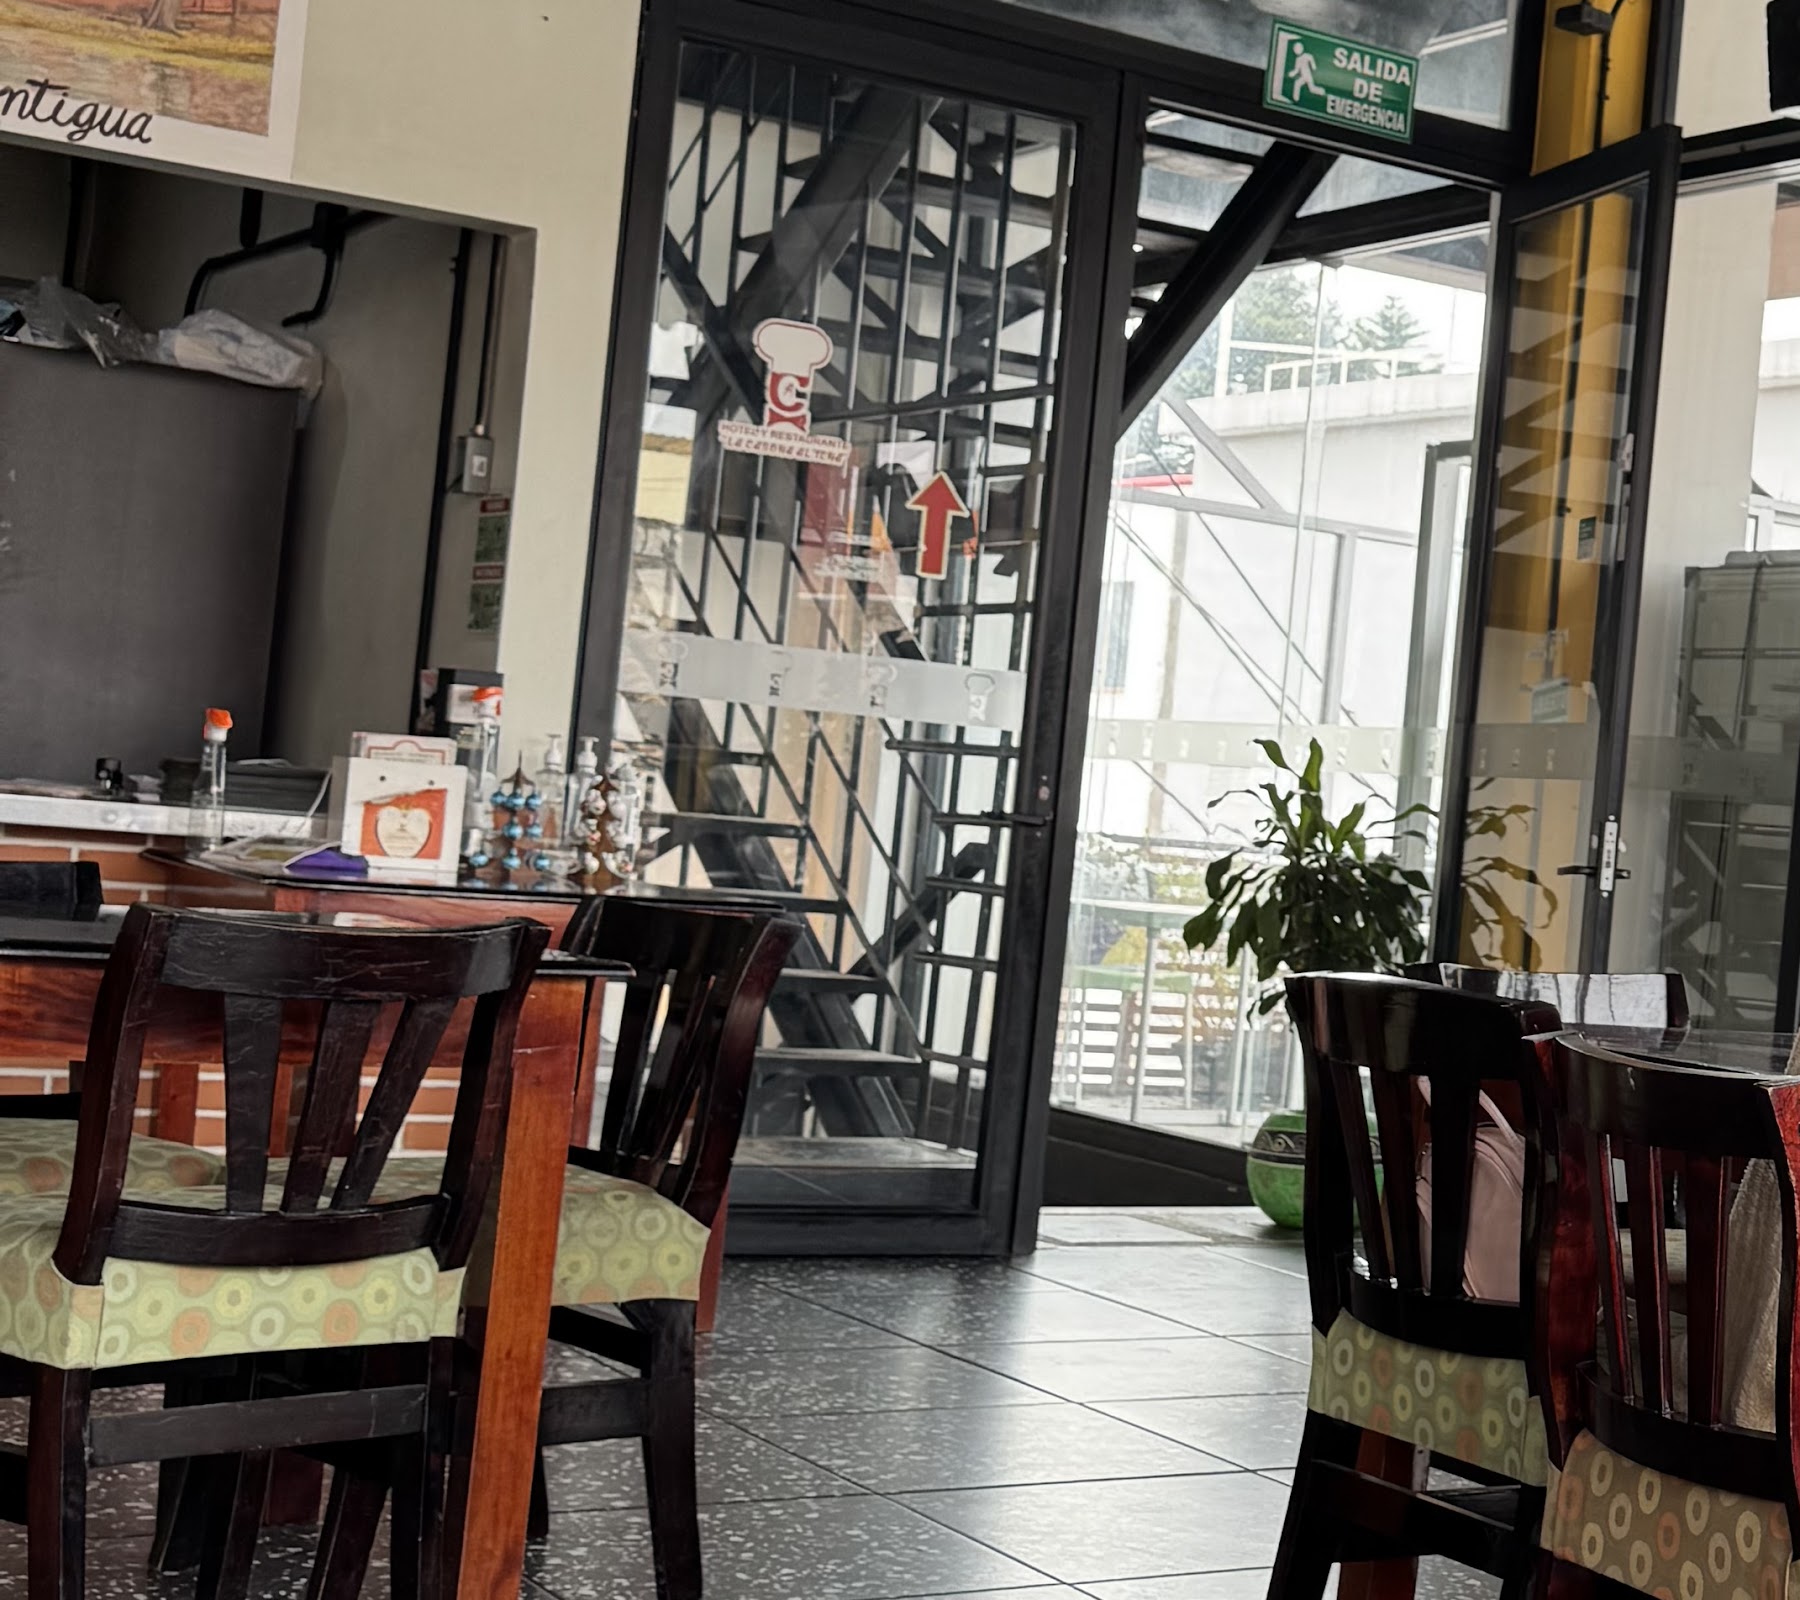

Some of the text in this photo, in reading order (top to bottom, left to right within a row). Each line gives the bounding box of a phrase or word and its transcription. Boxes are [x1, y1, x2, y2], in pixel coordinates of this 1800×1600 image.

[1333, 47, 1411, 87] SALIDA
[1352, 79, 1384, 103] DE
[1325, 95, 1406, 133] EMERGENCIA
